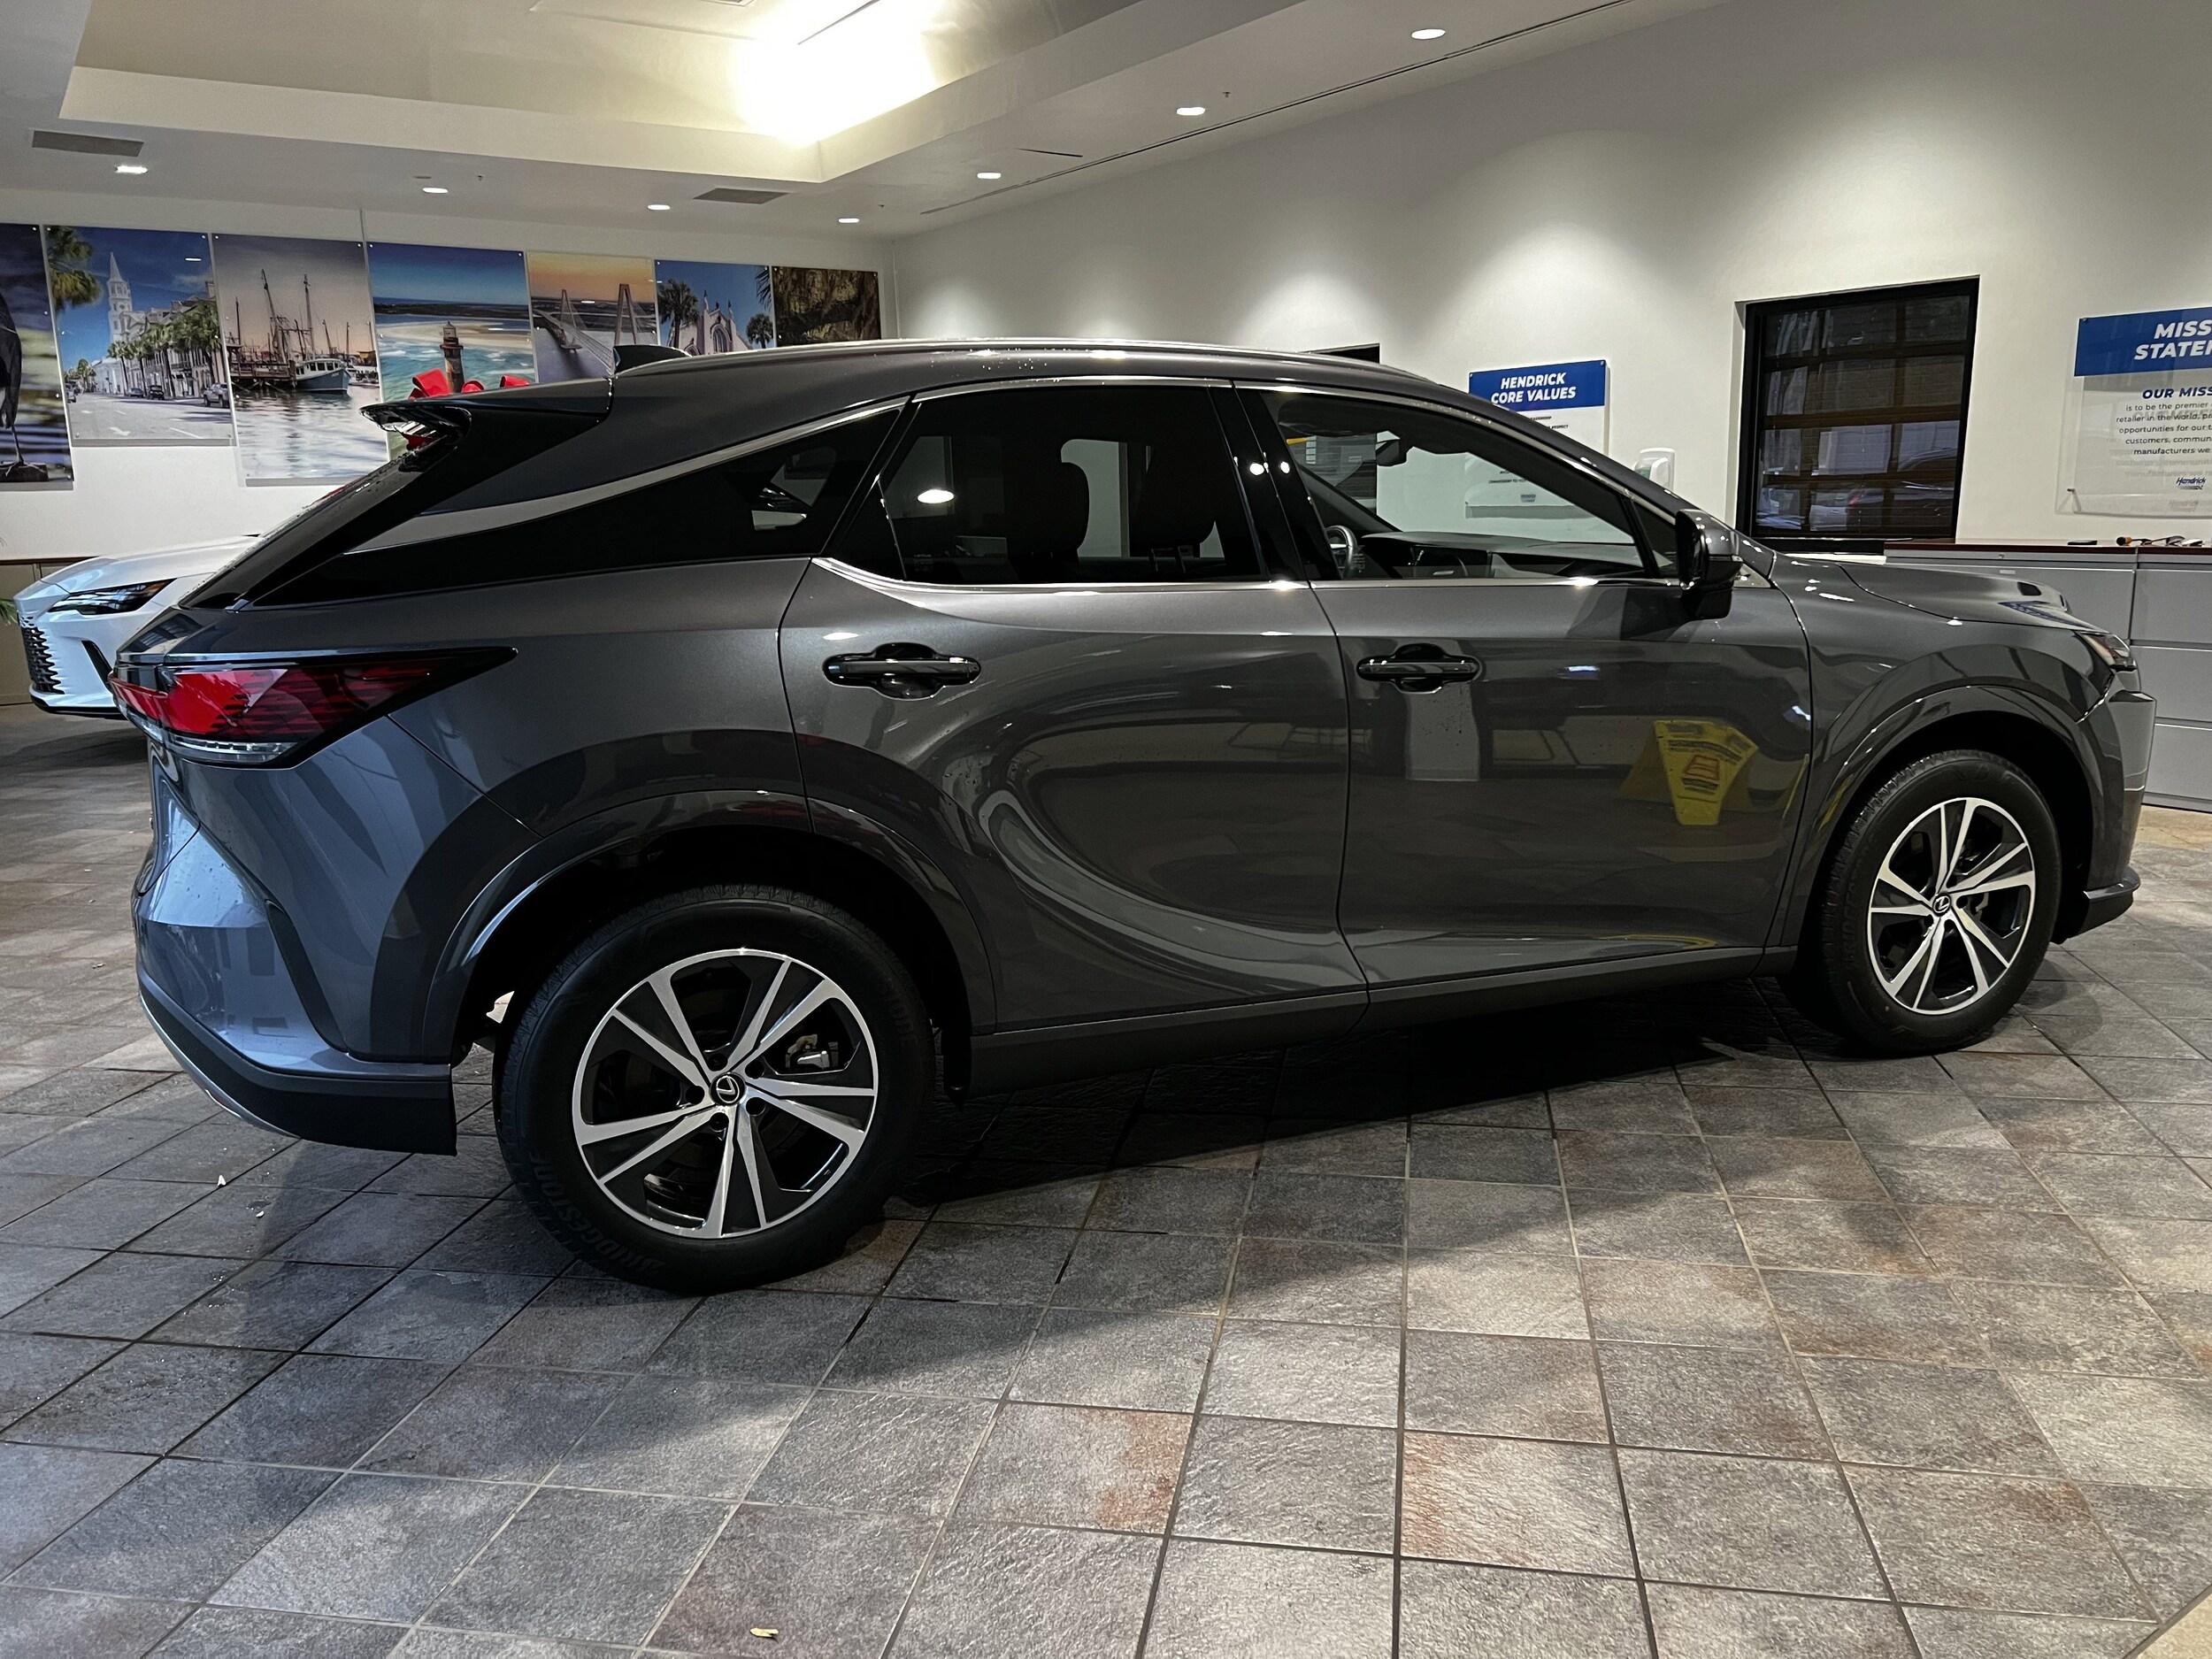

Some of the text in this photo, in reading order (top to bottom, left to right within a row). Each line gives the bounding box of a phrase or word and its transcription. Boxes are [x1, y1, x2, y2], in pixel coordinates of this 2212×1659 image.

[2154, 319, 2212, 339] MISS
[1501, 373, 1566, 389] HENDRICK
[1491, 386, 1577, 404] CORE VALUES
[2142, 388, 2175, 399] OUR
[2119, 425, 2174, 434] opportunities
[2176, 477, 2207, 486] Hendrick
